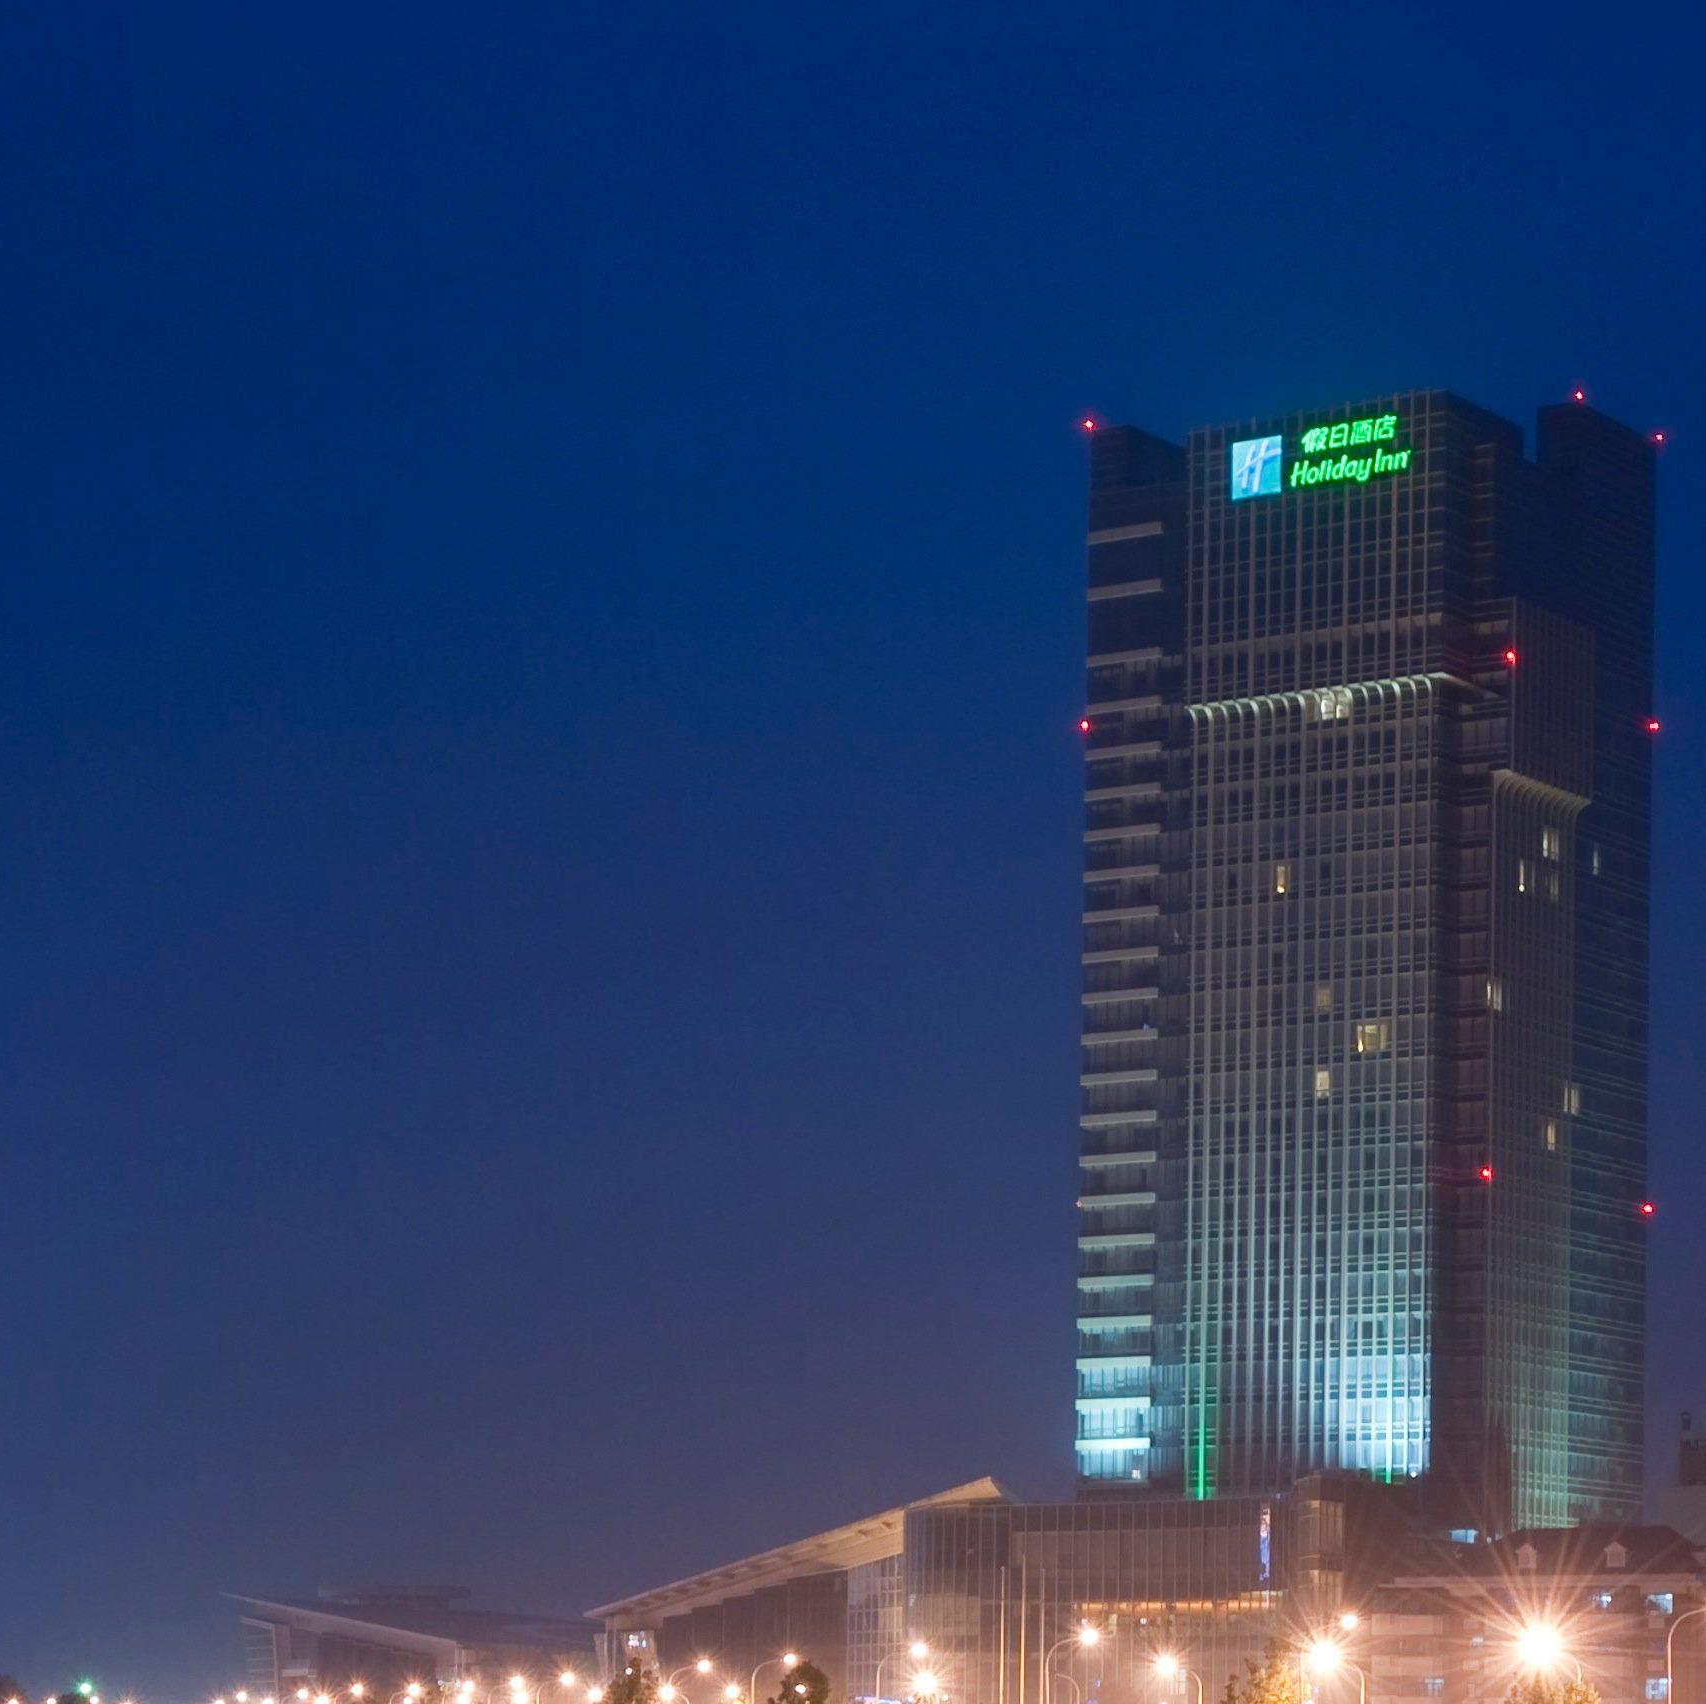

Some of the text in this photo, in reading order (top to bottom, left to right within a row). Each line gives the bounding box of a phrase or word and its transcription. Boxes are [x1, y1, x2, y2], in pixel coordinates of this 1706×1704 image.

[1301, 414, 1397, 453] 假日酒店
[1290, 448, 1410, 487] Holiday Inn
